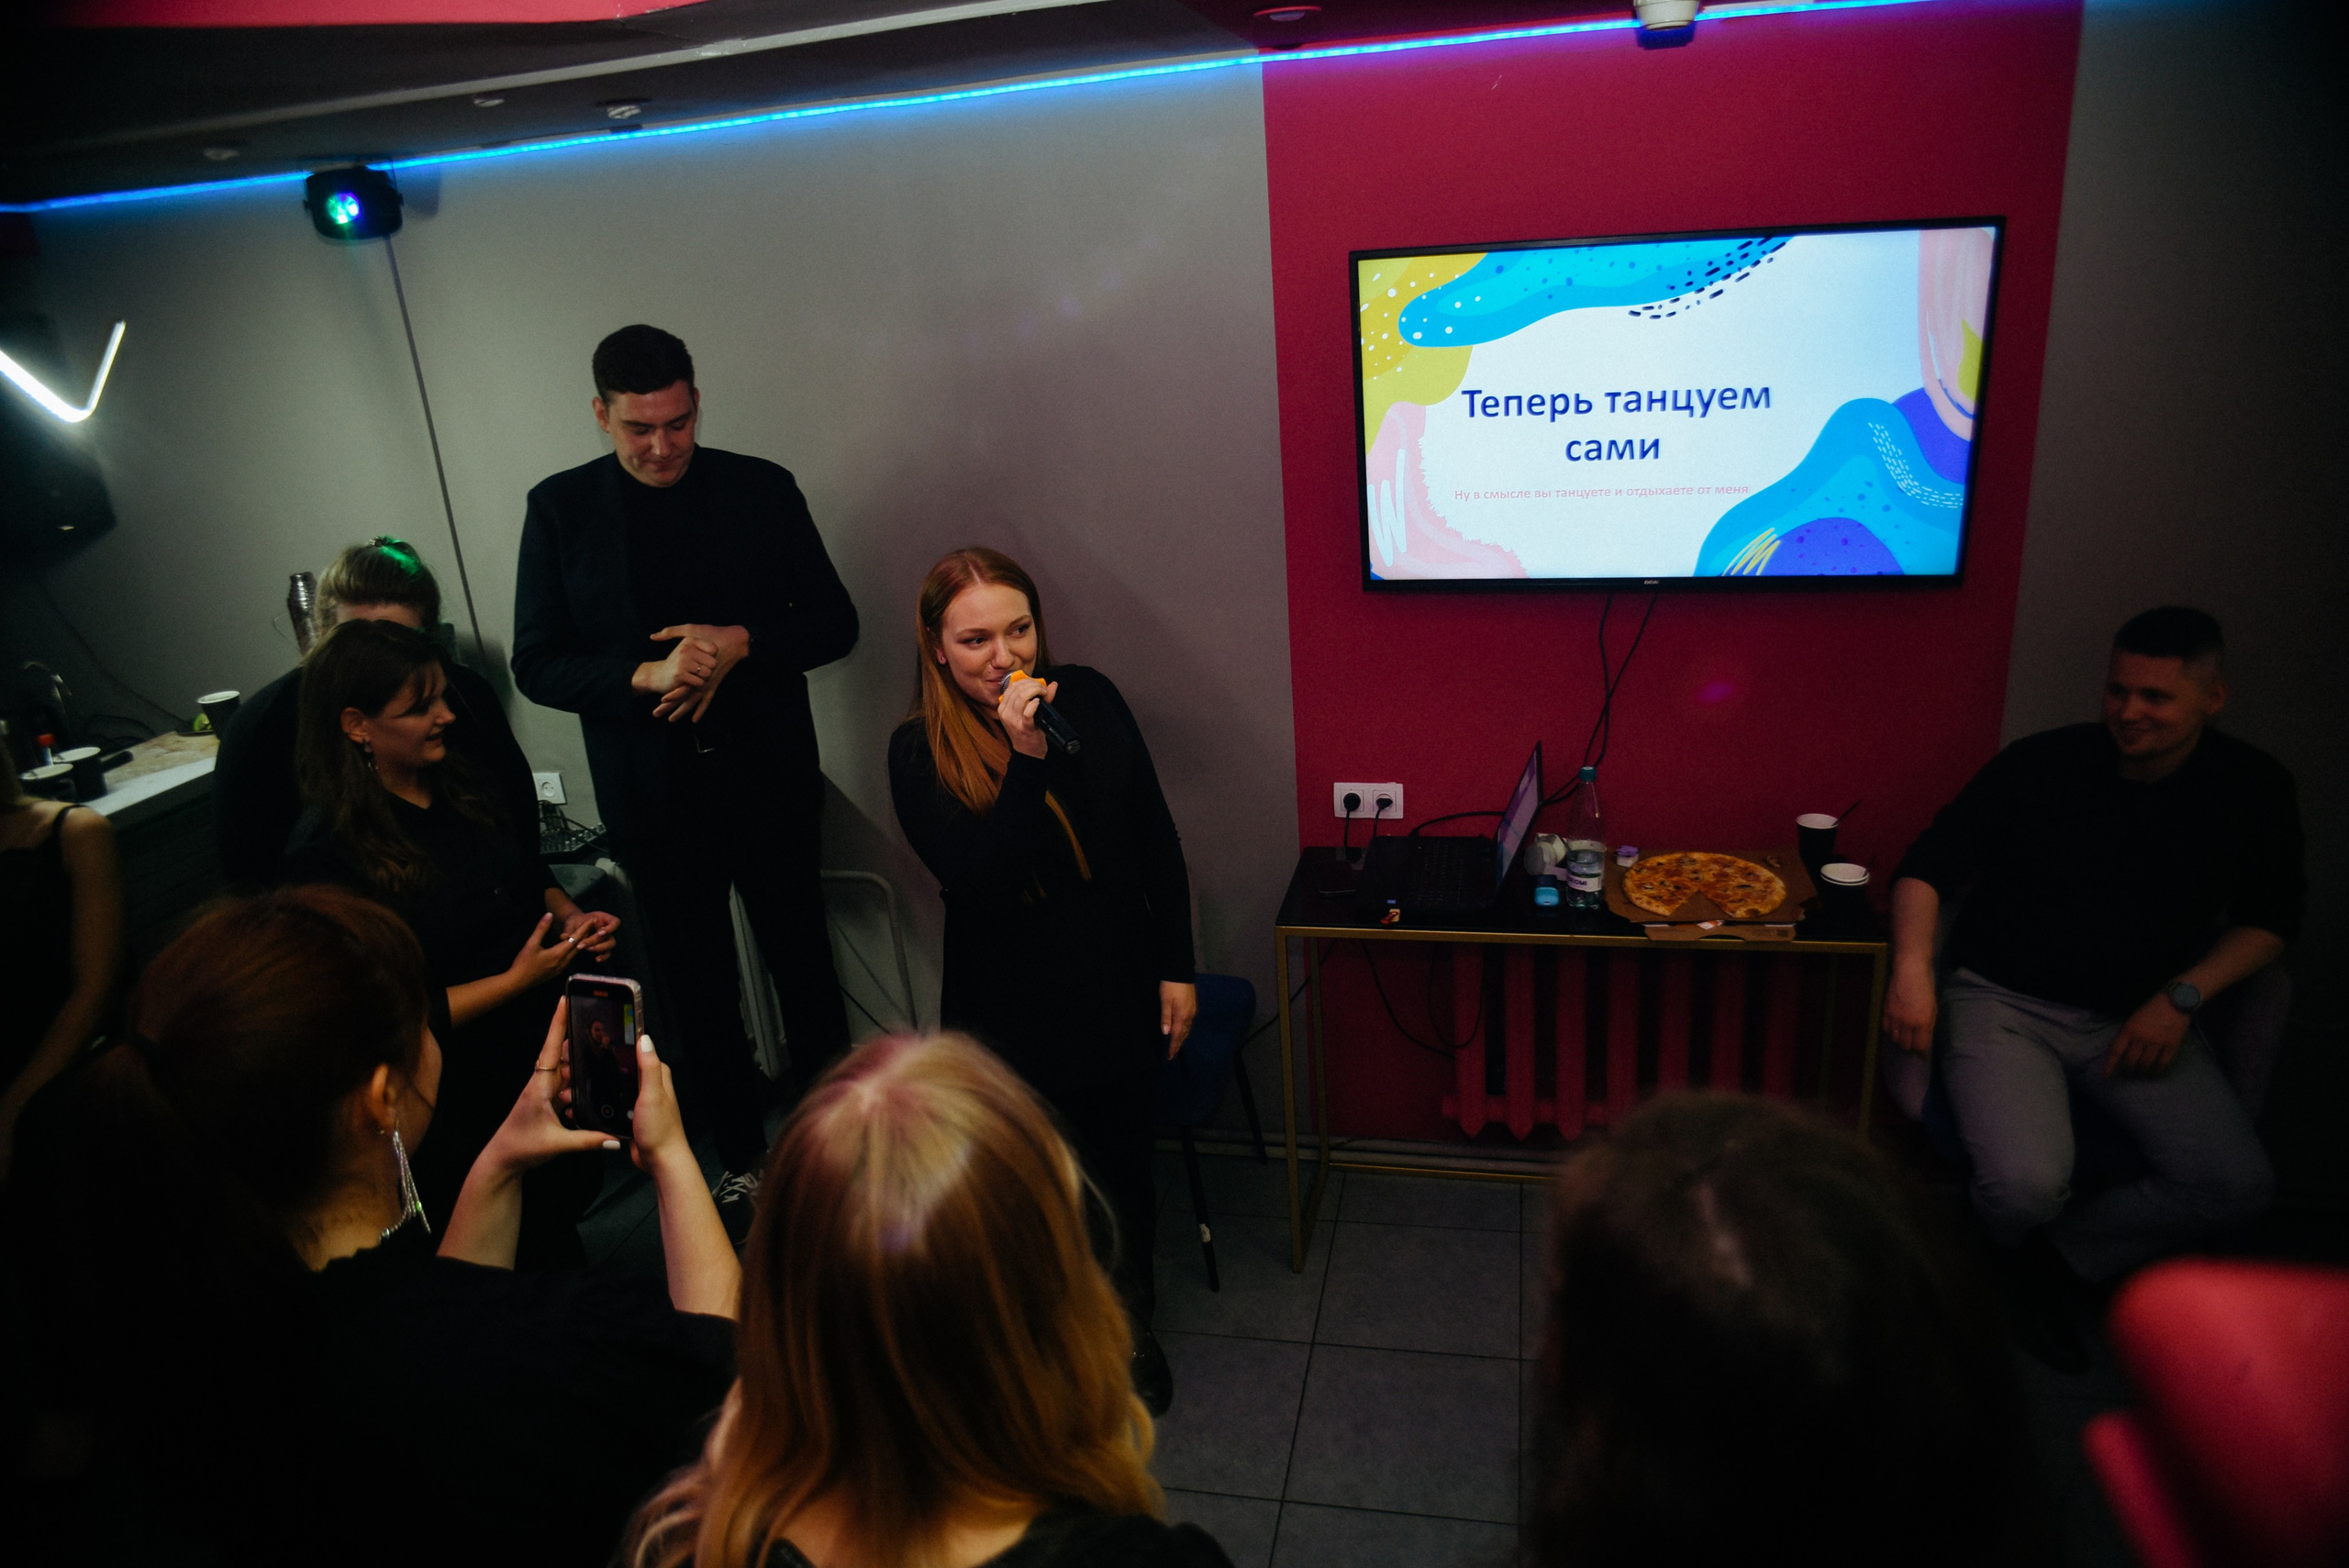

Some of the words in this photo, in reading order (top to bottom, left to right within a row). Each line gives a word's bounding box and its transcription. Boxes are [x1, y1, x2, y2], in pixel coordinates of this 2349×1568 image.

[1461, 389, 1593, 423] Теперь
[1604, 386, 1771, 418] танцуем
[1565, 438, 1660, 462] сами
[1454, 490, 1470, 502] Ну
[1484, 490, 1531, 499] смысле
[1534, 490, 1552, 498] вы
[1555, 488, 1611, 499] танцуете
[1615, 488, 1622, 496] и
[1626, 486, 1694, 498] отдыхаете
[1698, 486, 1711, 495] от
[1715, 485, 1748, 495] меня
